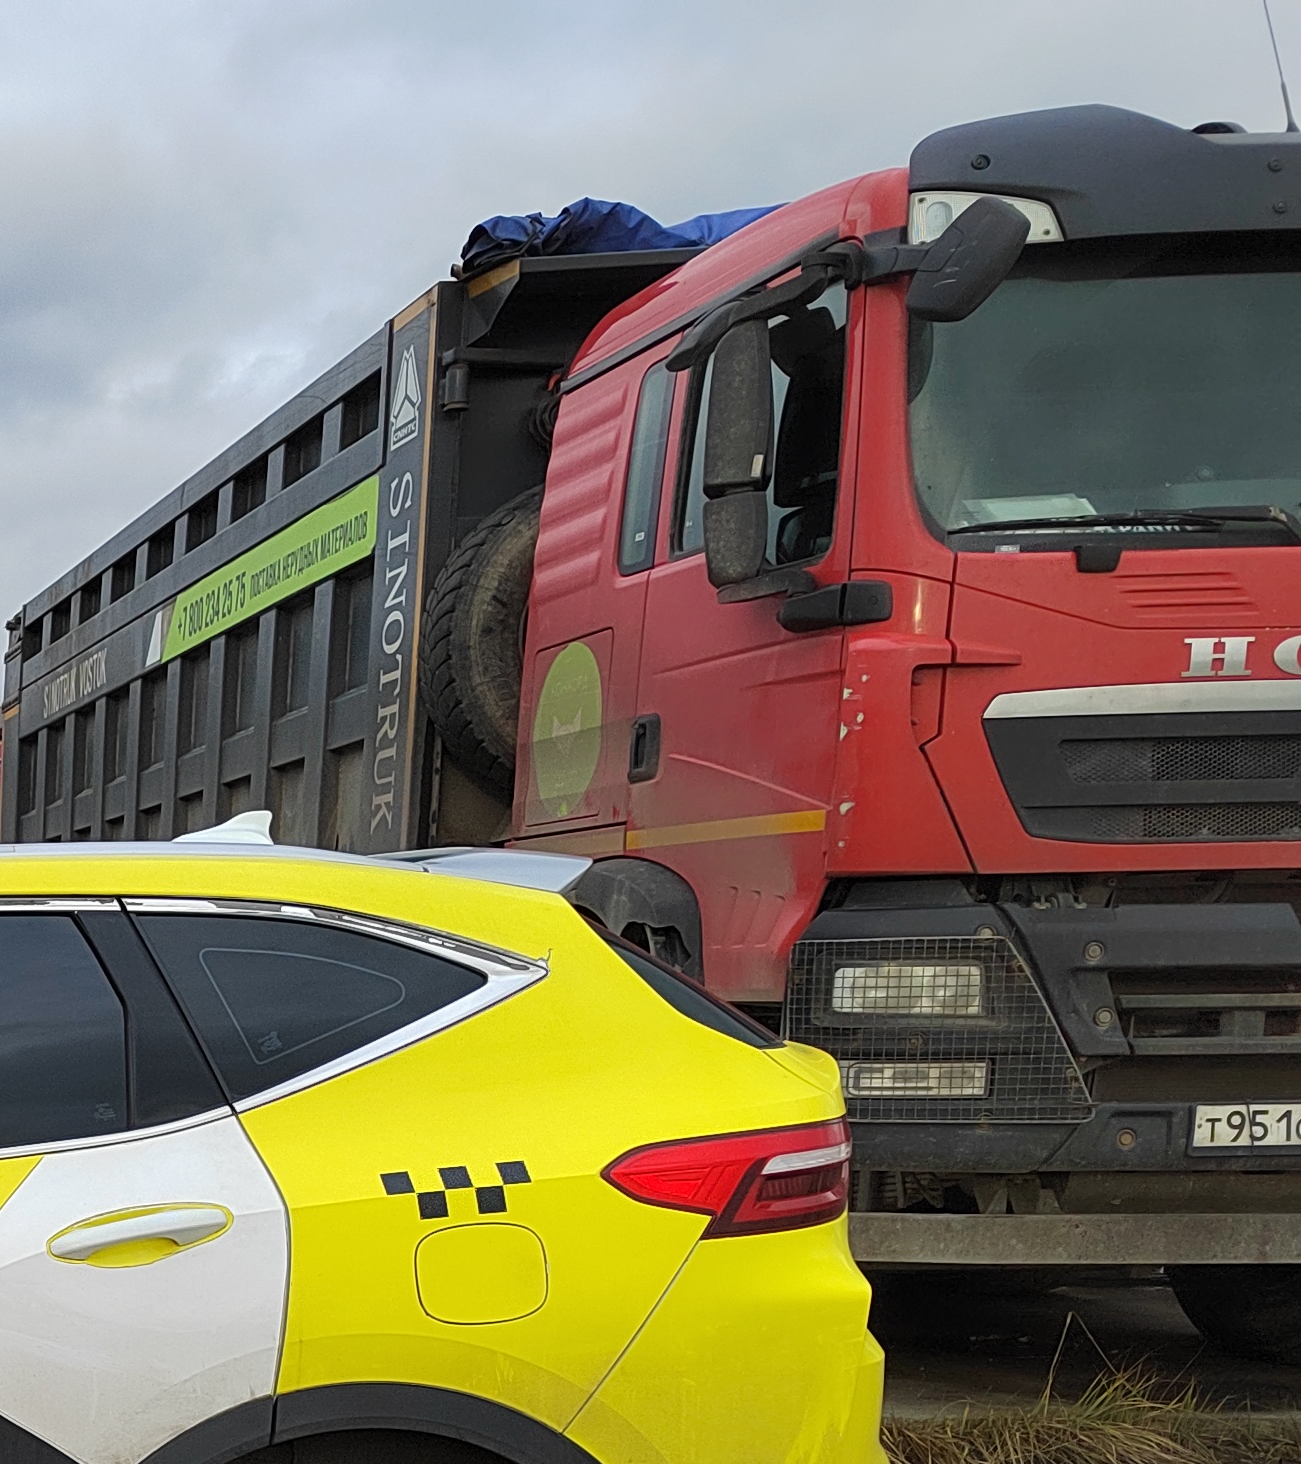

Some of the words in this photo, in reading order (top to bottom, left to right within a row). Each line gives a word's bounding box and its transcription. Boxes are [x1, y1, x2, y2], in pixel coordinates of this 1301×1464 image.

[188, 596, 204, 637] 800
[204, 586, 221, 629] 234
[221, 578, 234, 619] 25
[234, 570, 247, 612] 75
[370, 471, 413, 834] SINOTRUK
